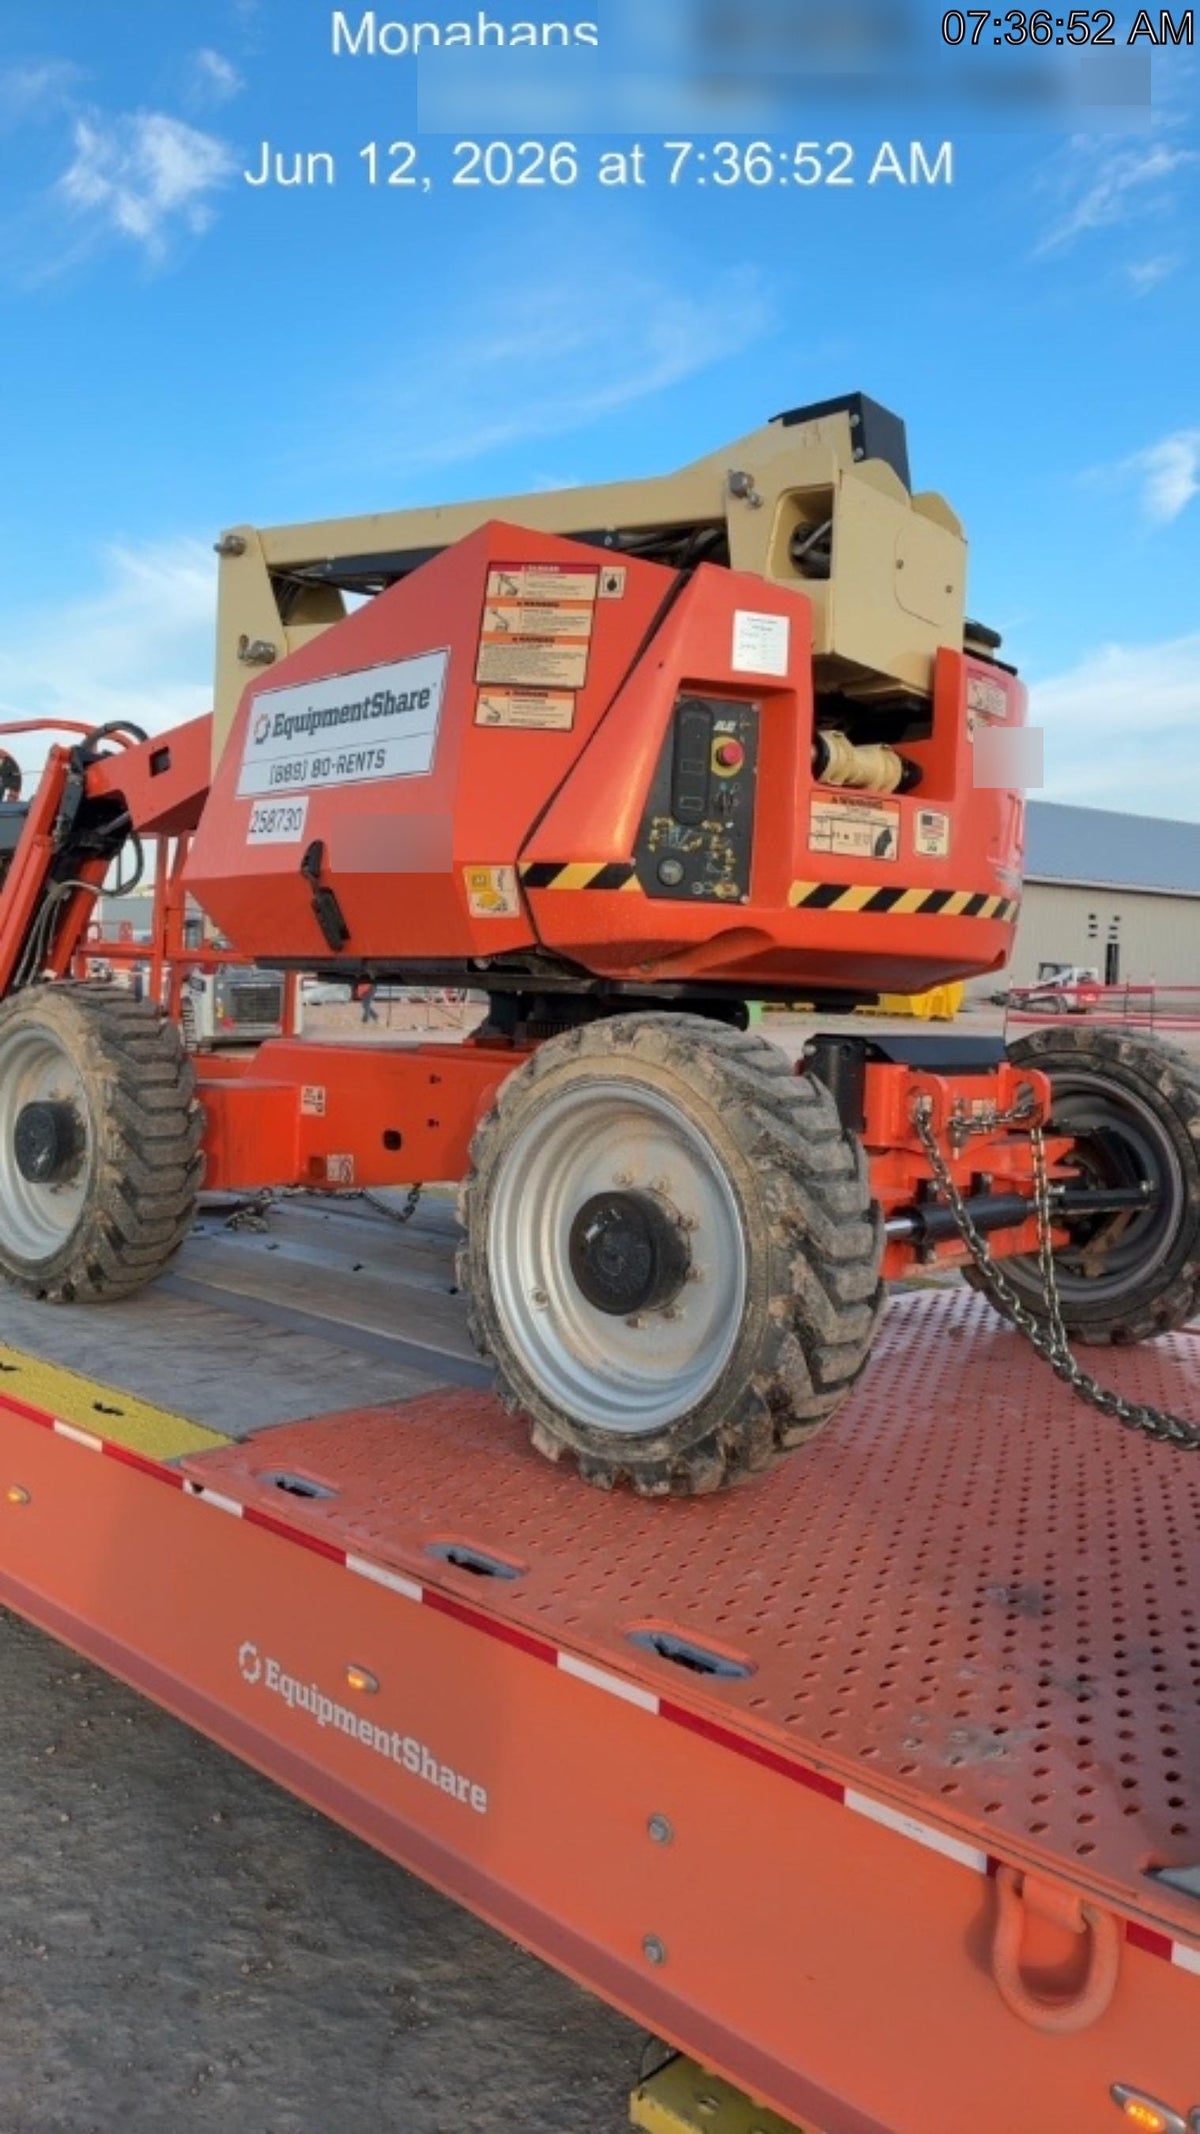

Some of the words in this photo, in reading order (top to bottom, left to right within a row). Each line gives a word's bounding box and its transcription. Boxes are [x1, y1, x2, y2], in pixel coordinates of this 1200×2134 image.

[272, 686, 431, 740] EquipmentShare
[310, 749, 386, 779] 80-RENTS
[249, 807, 303, 833] 258730
[264, 1657, 487, 1813] EquipmentShare
